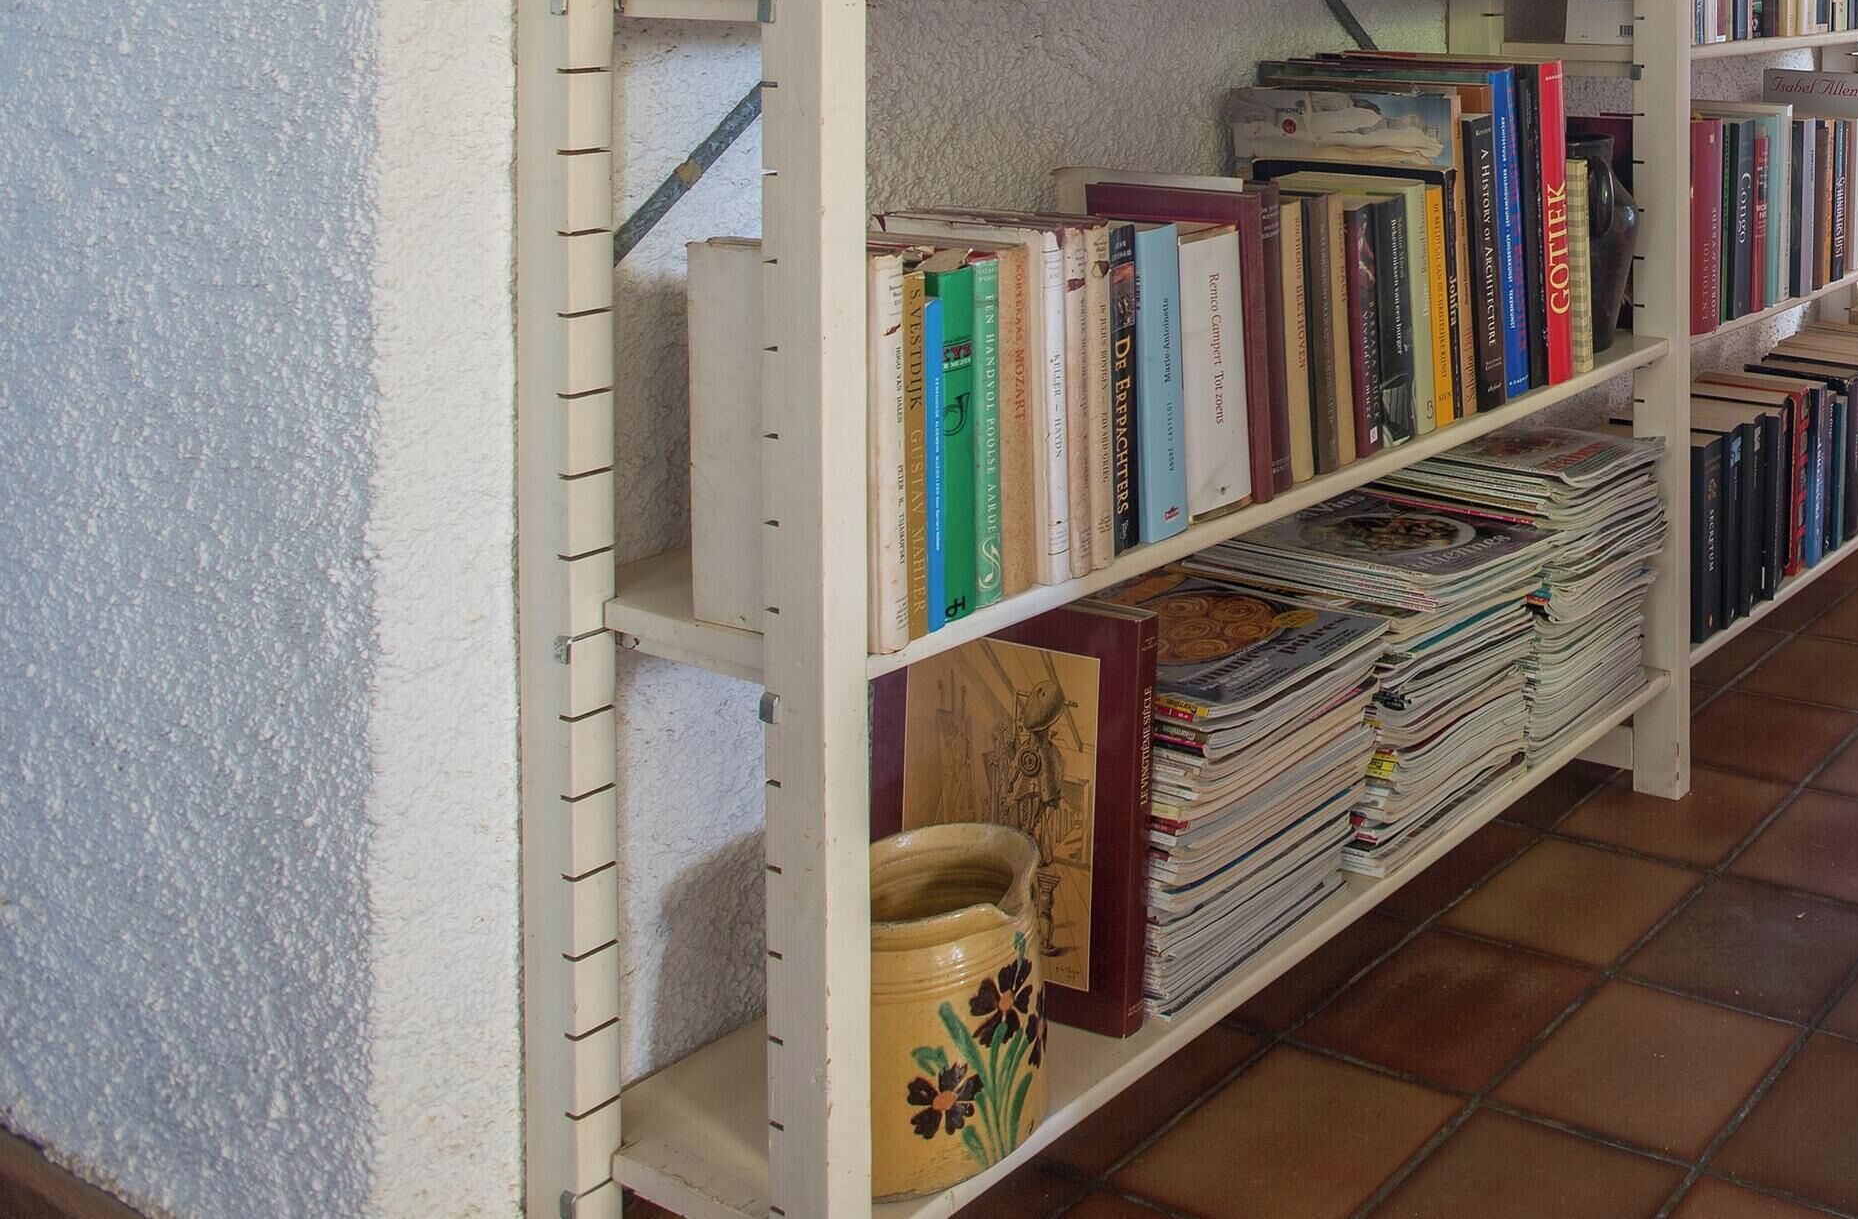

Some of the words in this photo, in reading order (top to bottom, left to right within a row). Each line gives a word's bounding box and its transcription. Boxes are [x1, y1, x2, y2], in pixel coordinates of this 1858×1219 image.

[1771, 76, 1815, 94] Isabel
[1481, 149, 1489, 159] A
[1481, 165, 1492, 223] HISTORY
[1738, 172, 1751, 244] Congo
[1547, 183, 1570, 315] GOTIEK
[985, 295, 995, 323] EEN
[1209, 272, 1221, 311] Remco
[1485, 247, 1496, 347] ARCHITECTURE
[1115, 336, 1132, 371] DE
[1163, 297, 1172, 383] Marie-Antoinette
[1206, 314, 1224, 365] Campert
[986, 334, 996, 411] HANDVOL
[1015, 349, 1025, 419] MOZART
[1214, 370, 1225, 390] Tot
[1215, 393, 1224, 424] zoens
[911, 429, 923, 513] GUSTAV
[986, 418, 996, 474] POOLSE
[1115, 379, 1132, 514] ERFPACHTERS
[987, 483, 997, 533] AARDE
[912, 527, 926, 614] MAHLER
[1142, 688, 1151, 725] SIÈCLE
[1141, 726, 1150, 789] VINGTIÈME
[1140, 791, 1147, 805] LE
